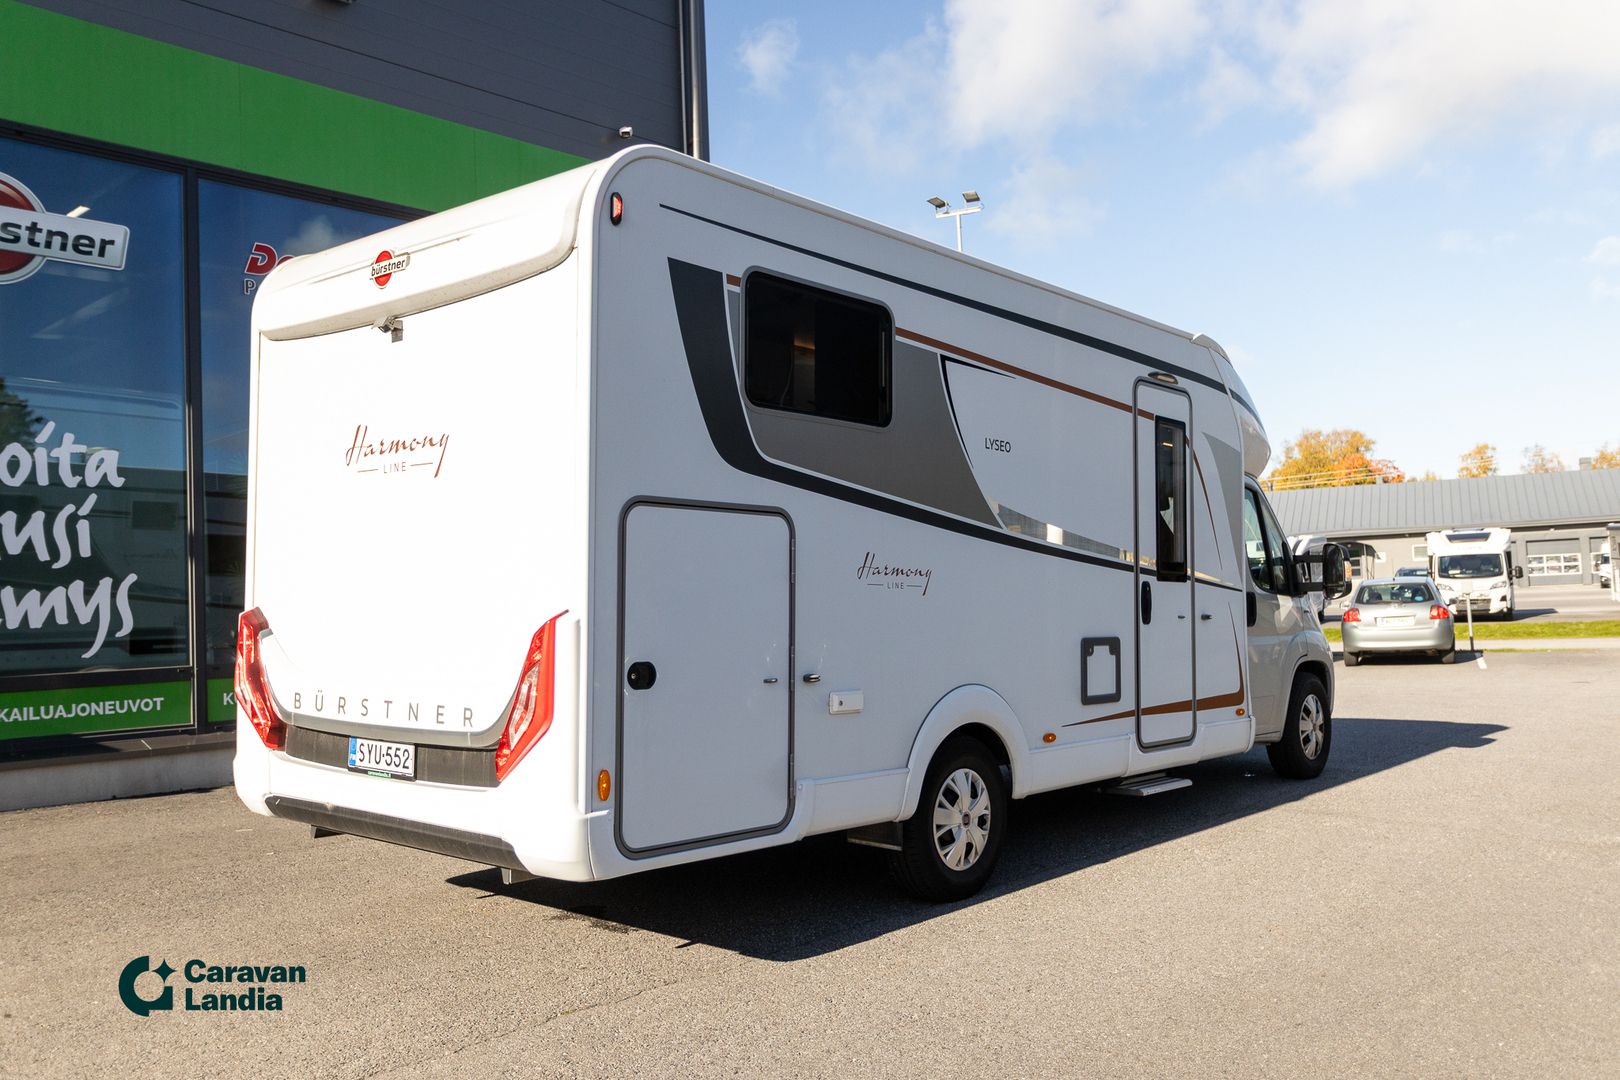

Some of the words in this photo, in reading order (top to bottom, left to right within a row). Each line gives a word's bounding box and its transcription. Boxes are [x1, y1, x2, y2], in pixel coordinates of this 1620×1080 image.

[245, 242, 295, 276] D
[371, 259, 406, 277] bürstner
[345, 424, 449, 478] Harmony
[984, 437, 1012, 453] LYSEO
[383, 461, 407, 474] LINE
[856, 551, 933, 597] Harmony
[886, 581, 905, 590] LINE
[293, 689, 474, 728] BÜRSTNER
[358, 743, 411, 770] SYU-552
